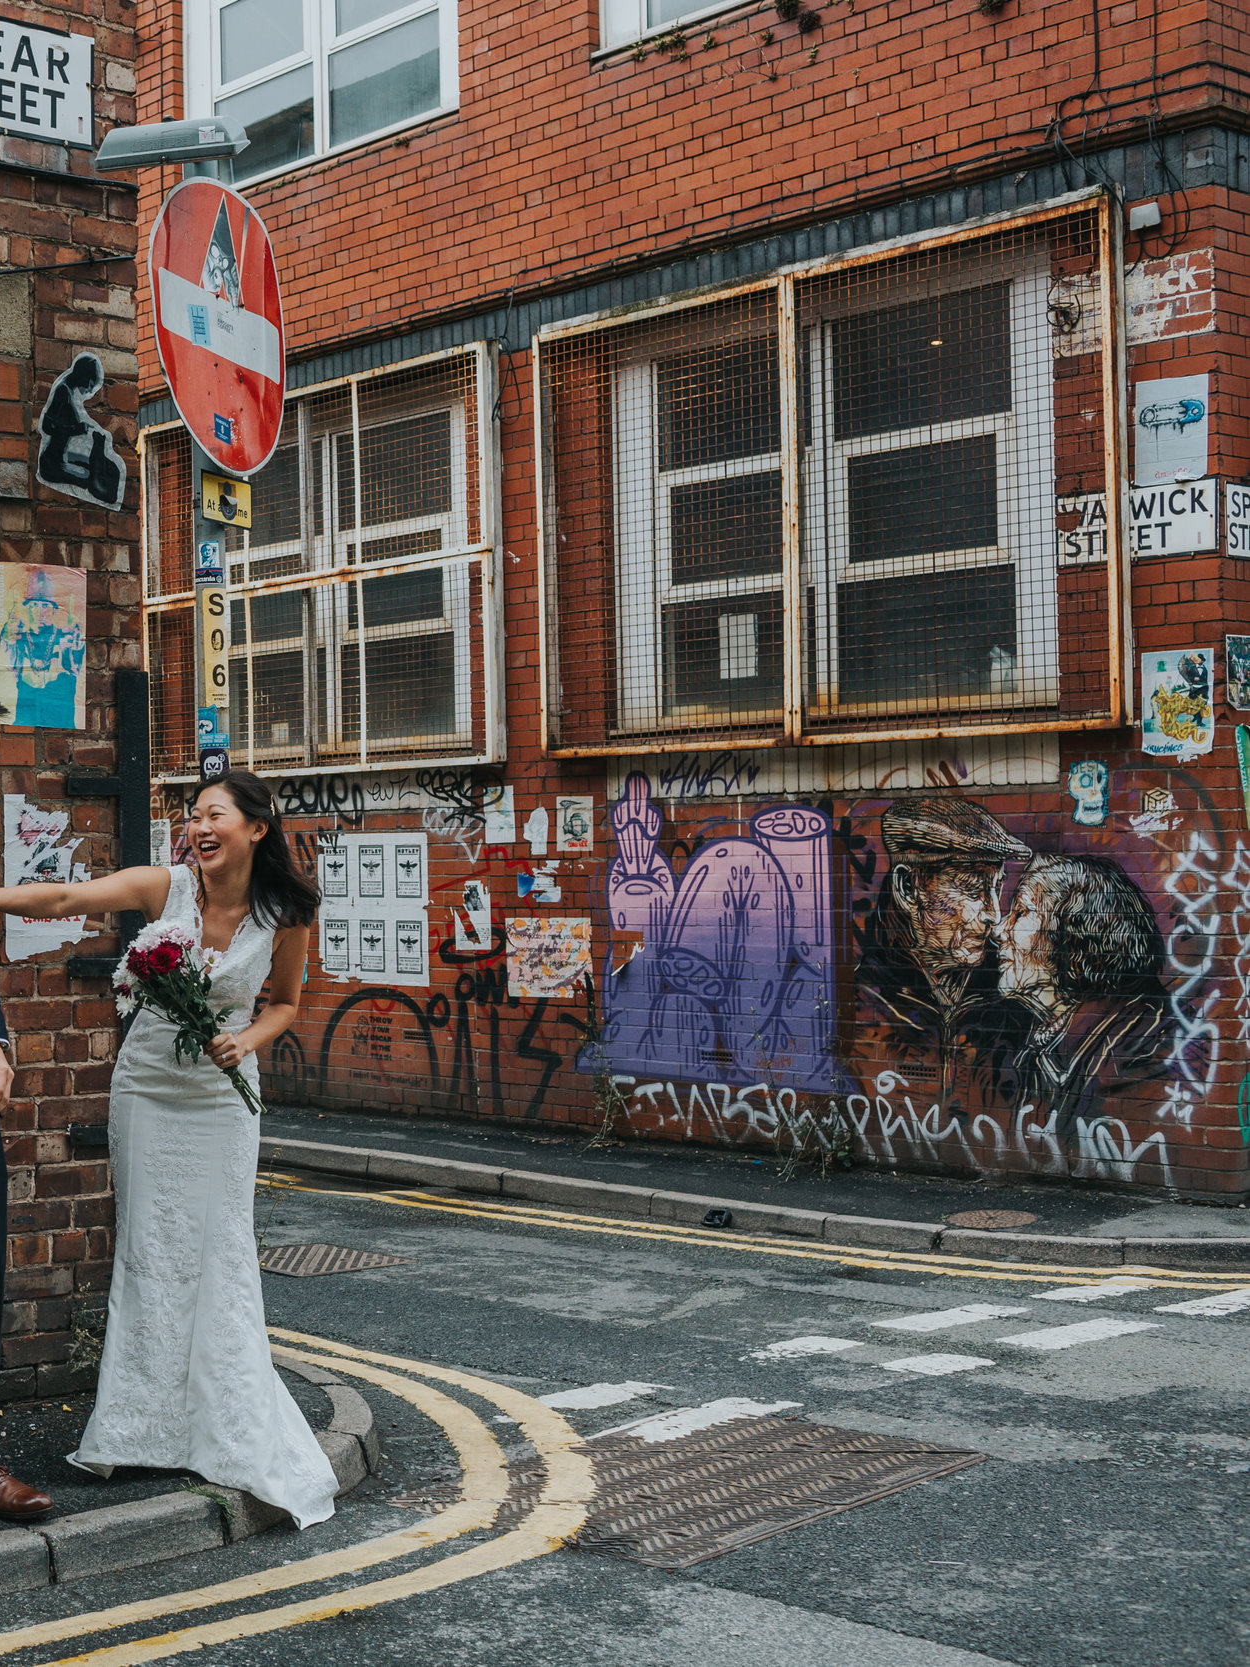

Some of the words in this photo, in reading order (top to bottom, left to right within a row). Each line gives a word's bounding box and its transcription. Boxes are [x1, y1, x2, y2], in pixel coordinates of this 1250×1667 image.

[207, 499, 216, 511] At
[1058, 487, 1208, 527] WAWICK
[1066, 522, 1172, 558] STET
[369, 1016, 393, 1024] THROW
[378, 1044, 391, 1052] THE
